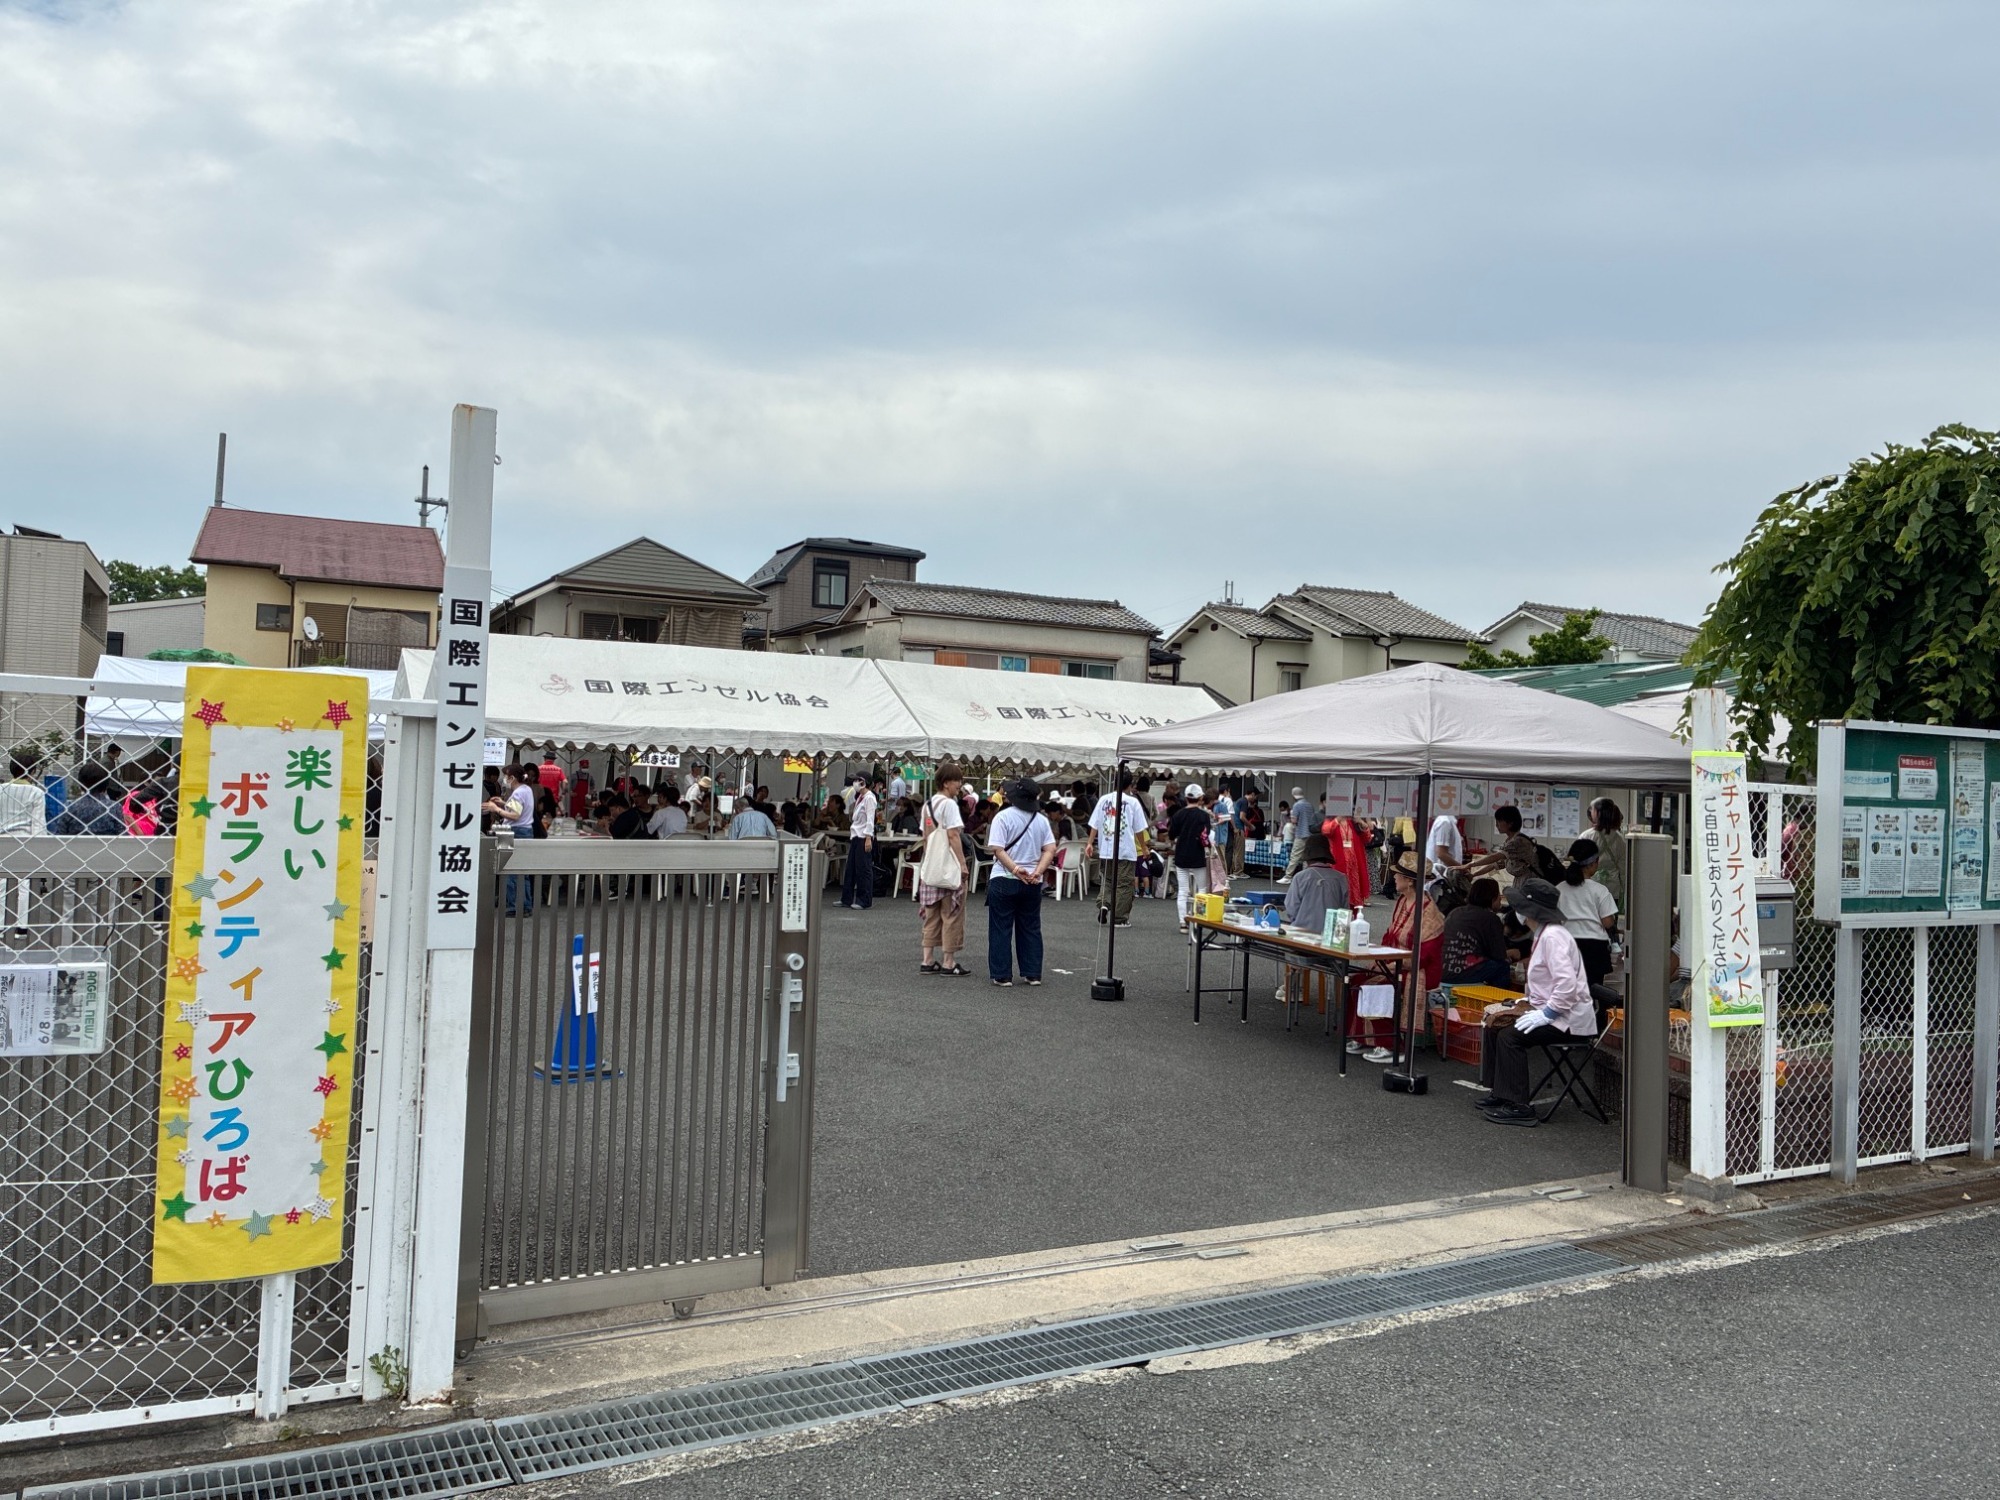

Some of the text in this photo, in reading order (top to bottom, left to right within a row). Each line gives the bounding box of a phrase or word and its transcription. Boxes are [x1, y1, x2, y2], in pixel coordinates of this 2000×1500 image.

[437, 598, 483, 914] 国際エンゼル協会
[584, 679, 829, 708] 国際エンゼル協会
[284, 745, 333, 880] 楽しい
[1703, 796, 1728, 984] ご自由にお入りください
[1721, 784, 1753, 998] チャリティイベント
[38, 1020, 51, 1044] 6/8
[85, 970, 97, 1007] ANGEL
[199, 772, 271, 1201] ボランティアひろば
